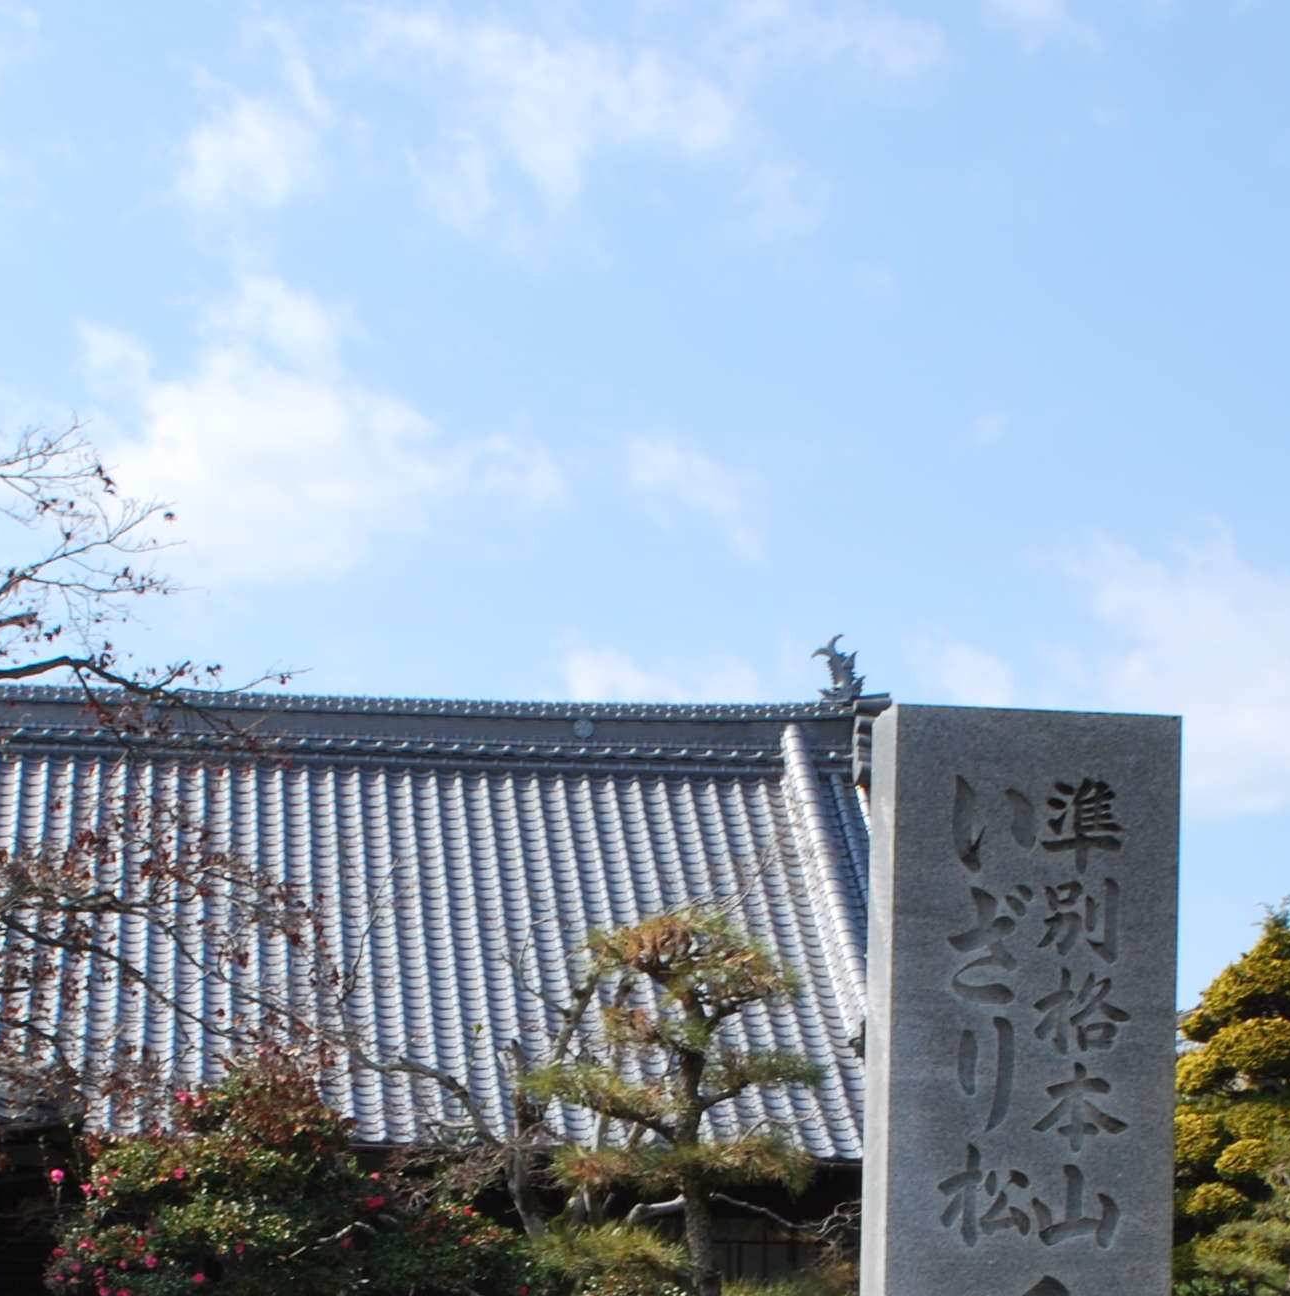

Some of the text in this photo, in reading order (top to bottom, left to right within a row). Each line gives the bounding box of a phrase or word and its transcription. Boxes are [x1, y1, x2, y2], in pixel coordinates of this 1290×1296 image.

[1031, 775, 1131, 1249] 準別格本山
